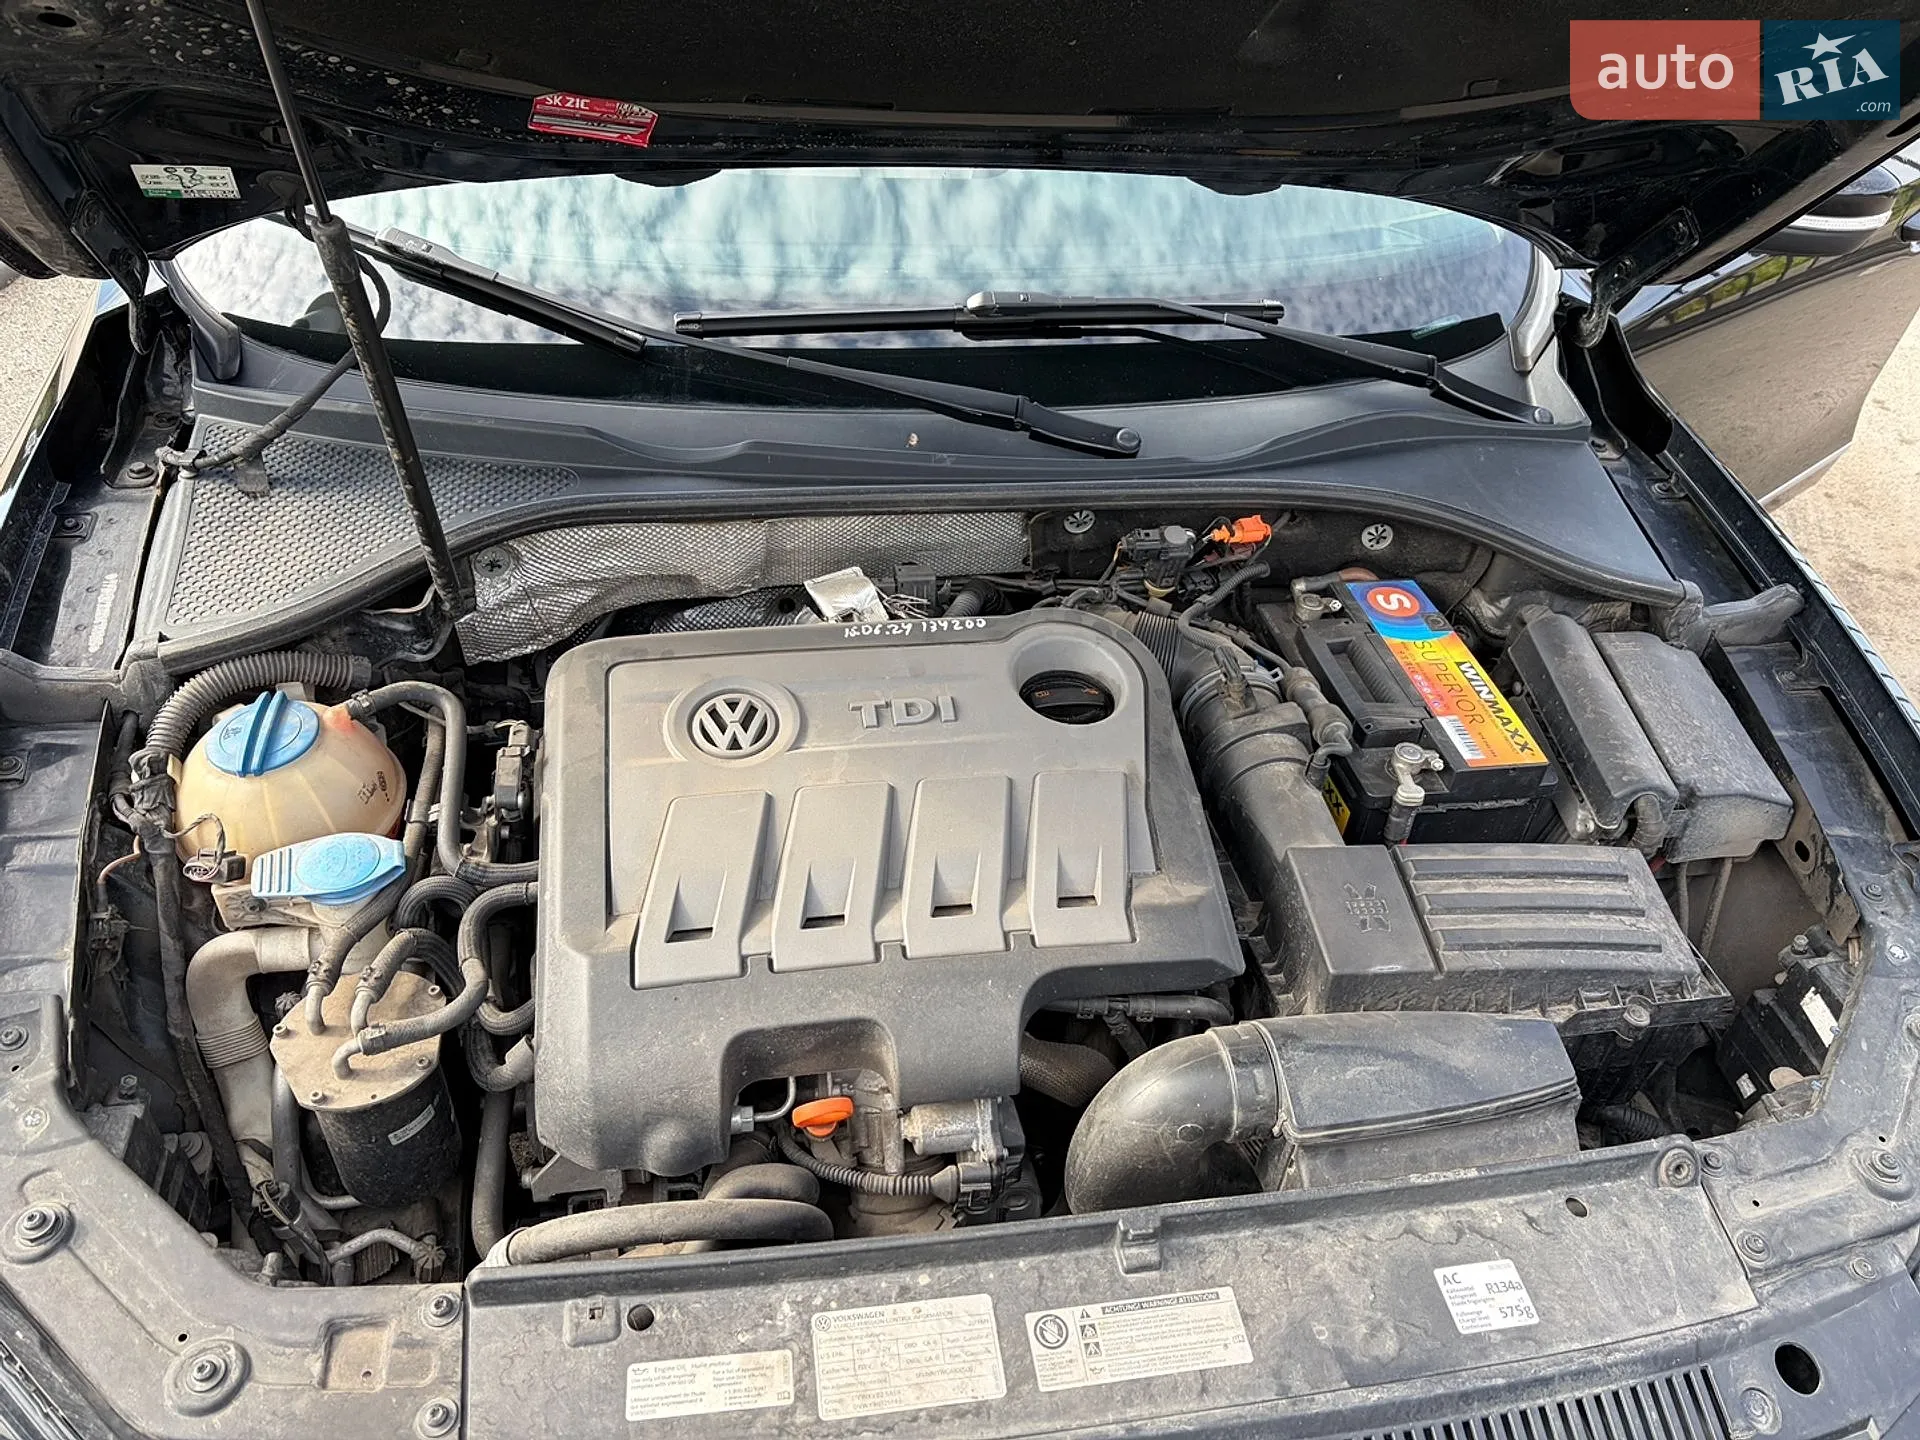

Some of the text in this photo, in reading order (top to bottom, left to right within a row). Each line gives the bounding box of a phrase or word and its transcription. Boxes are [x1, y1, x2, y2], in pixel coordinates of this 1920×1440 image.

[545, 95, 591, 110] SK ZIC
[1376, 591, 1413, 613] S
[921, 618, 987, 633] 134200
[1413, 639, 1486, 726] SUPERIOR
[849, 696, 956, 729] TDI
[1458, 661, 1533, 755] WINMAXX
[692, 694, 777, 758] VW
[1442, 1272, 1462, 1286] AC
[1485, 1280, 1524, 1294] R134a
[1103, 1291, 1217, 1314] ACHTUNG! WARNING! ATTENTION!
[1498, 1304, 1535, 1319] 575g
[832, 1310, 885, 1322] VOLKSWAGEN
